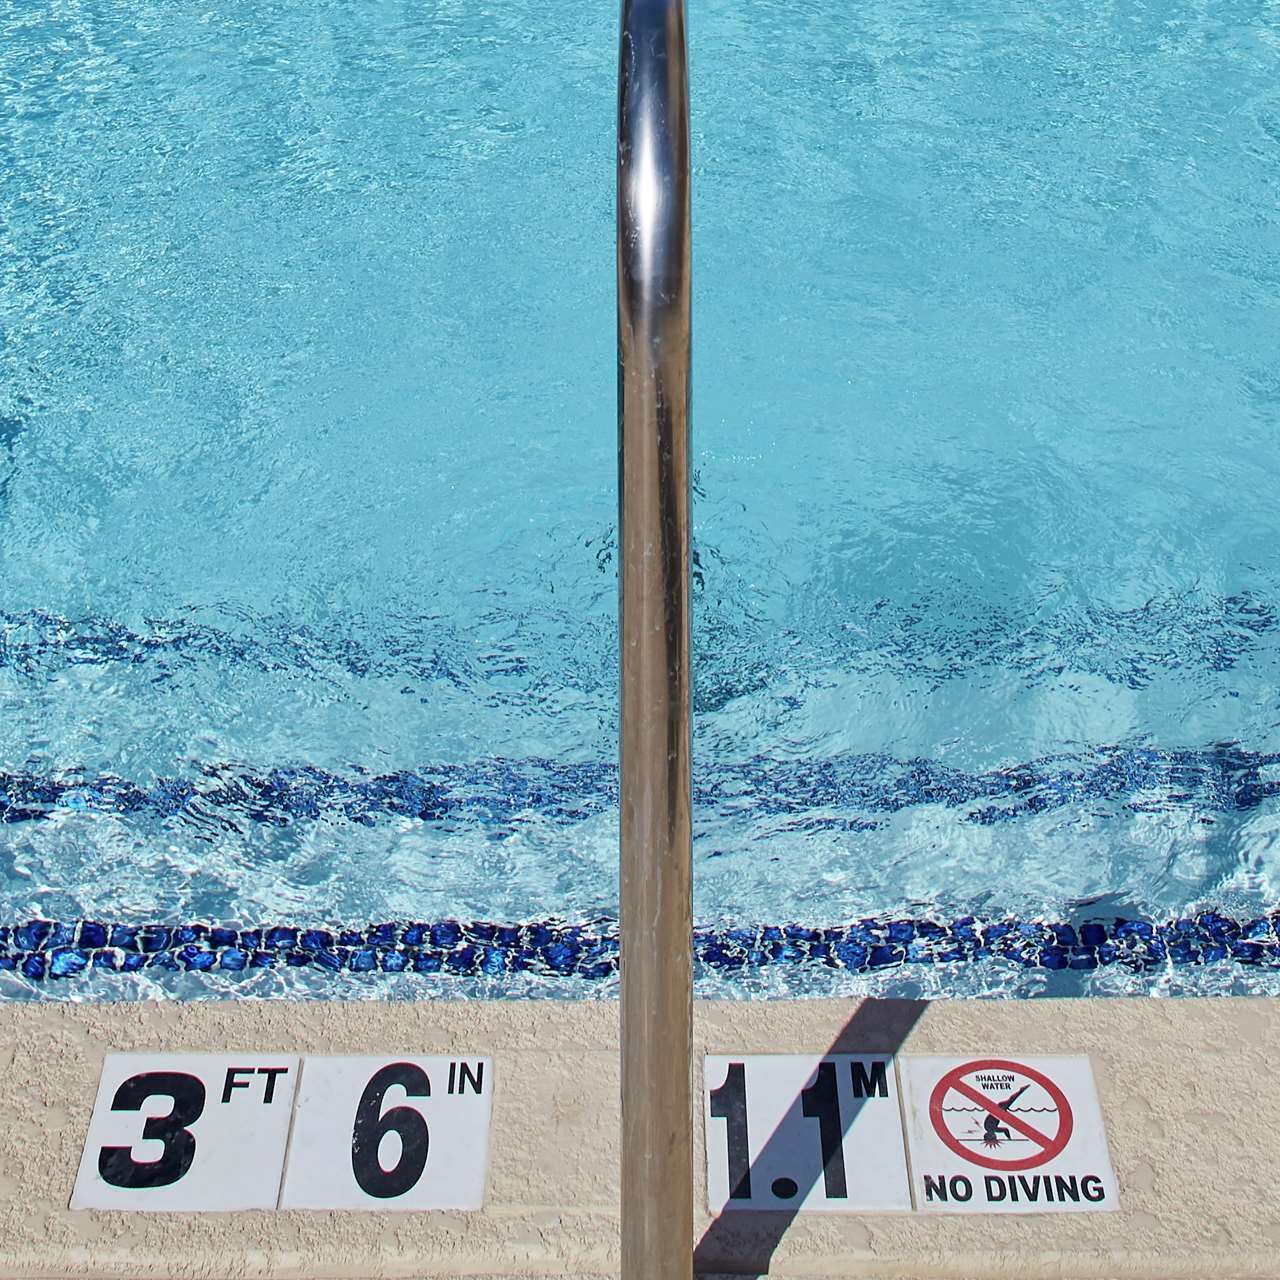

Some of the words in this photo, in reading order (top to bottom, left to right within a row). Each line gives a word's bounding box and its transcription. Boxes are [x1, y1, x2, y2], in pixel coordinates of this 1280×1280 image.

[975, 1074, 1015, 1083] SHALLOW
[981, 1082, 1012, 1091] WATER
[98, 1070, 207, 1189] 3
[220, 1067, 289, 1104] FT
[351, 1061, 432, 1199] 6
[447, 1061, 484, 1095] IN
[709, 1061, 849, 1200] 1.1
[850, 1061, 889, 1098] M
[923, 1175, 974, 1203] NO
[983, 1174, 1106, 1203] DIVING
